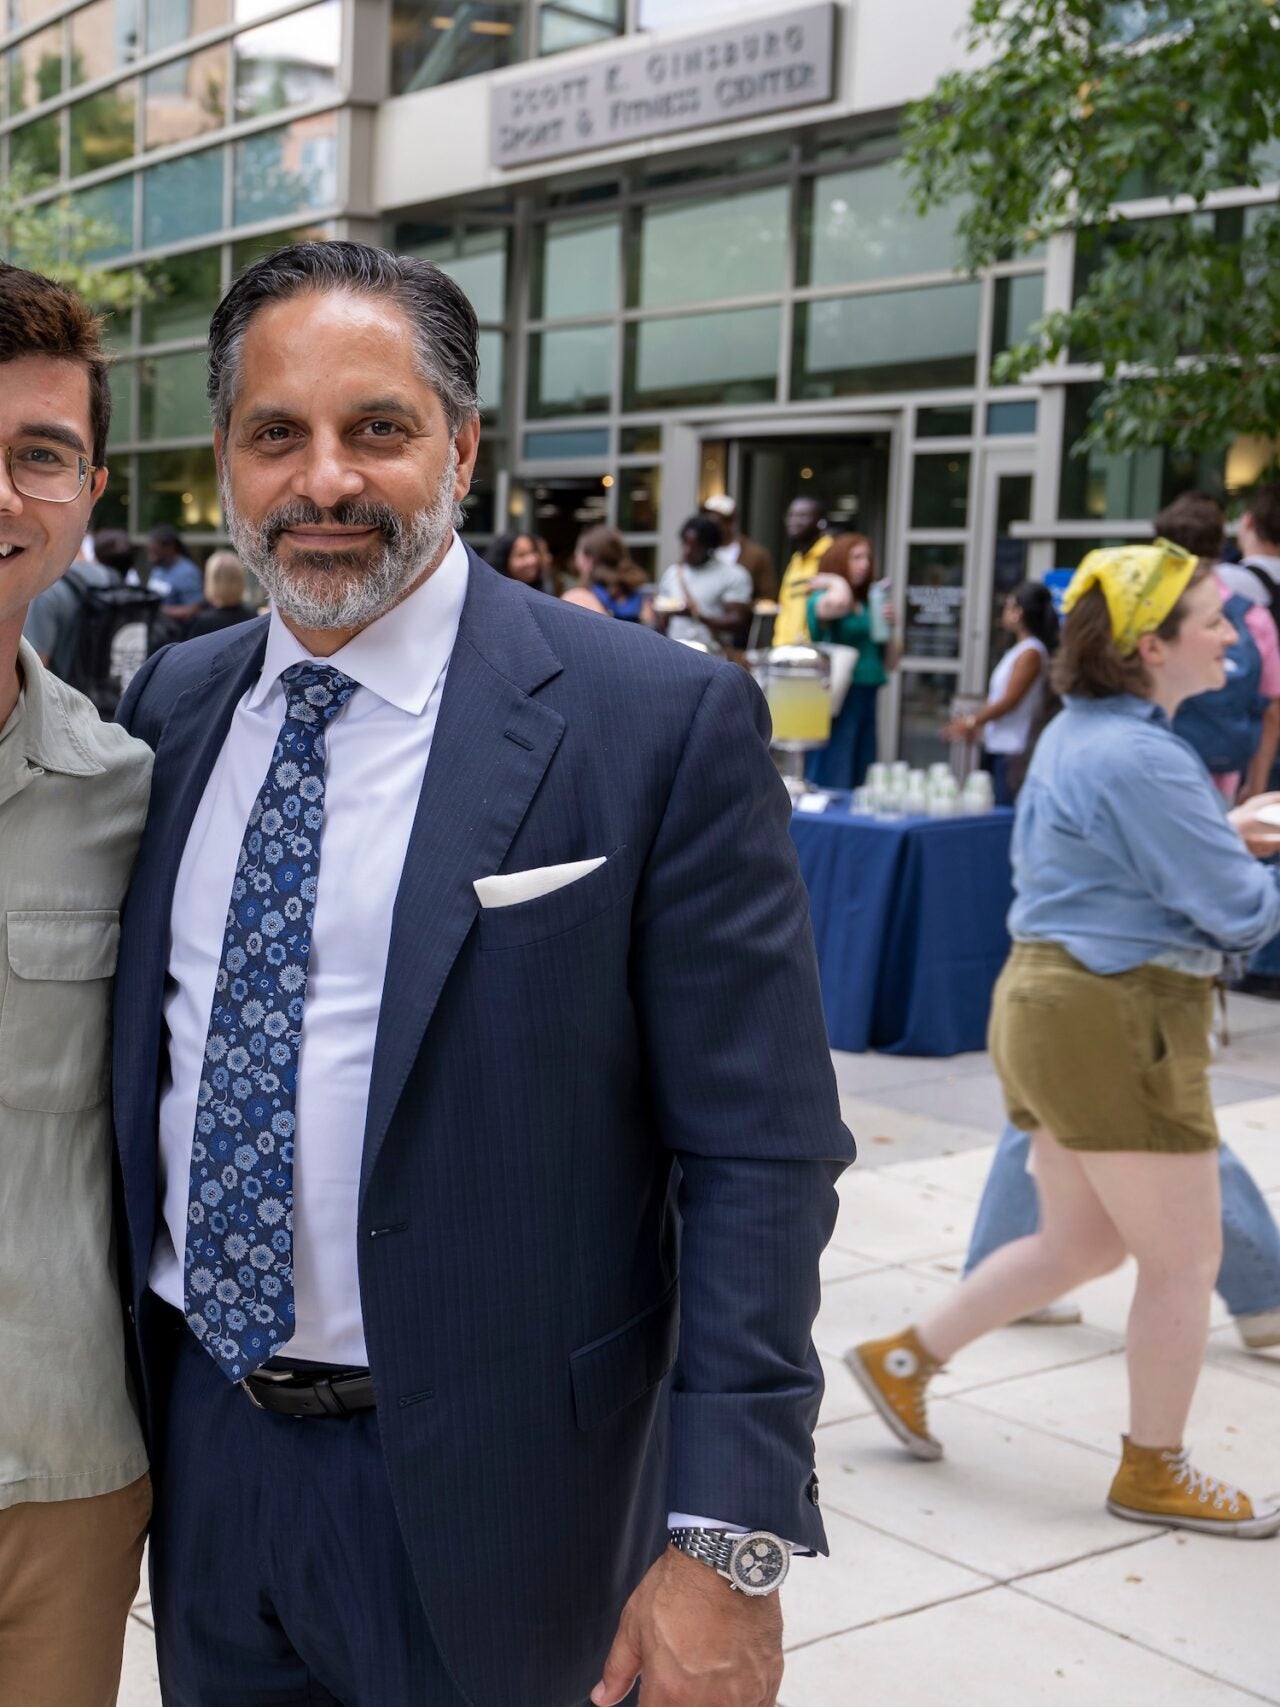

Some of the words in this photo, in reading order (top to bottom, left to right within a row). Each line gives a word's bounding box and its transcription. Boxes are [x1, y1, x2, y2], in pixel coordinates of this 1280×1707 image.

[511, 75, 589, 118] SCOTT
[645, 23, 805, 84] GINSBURG
[575, 107, 594, 138] &
